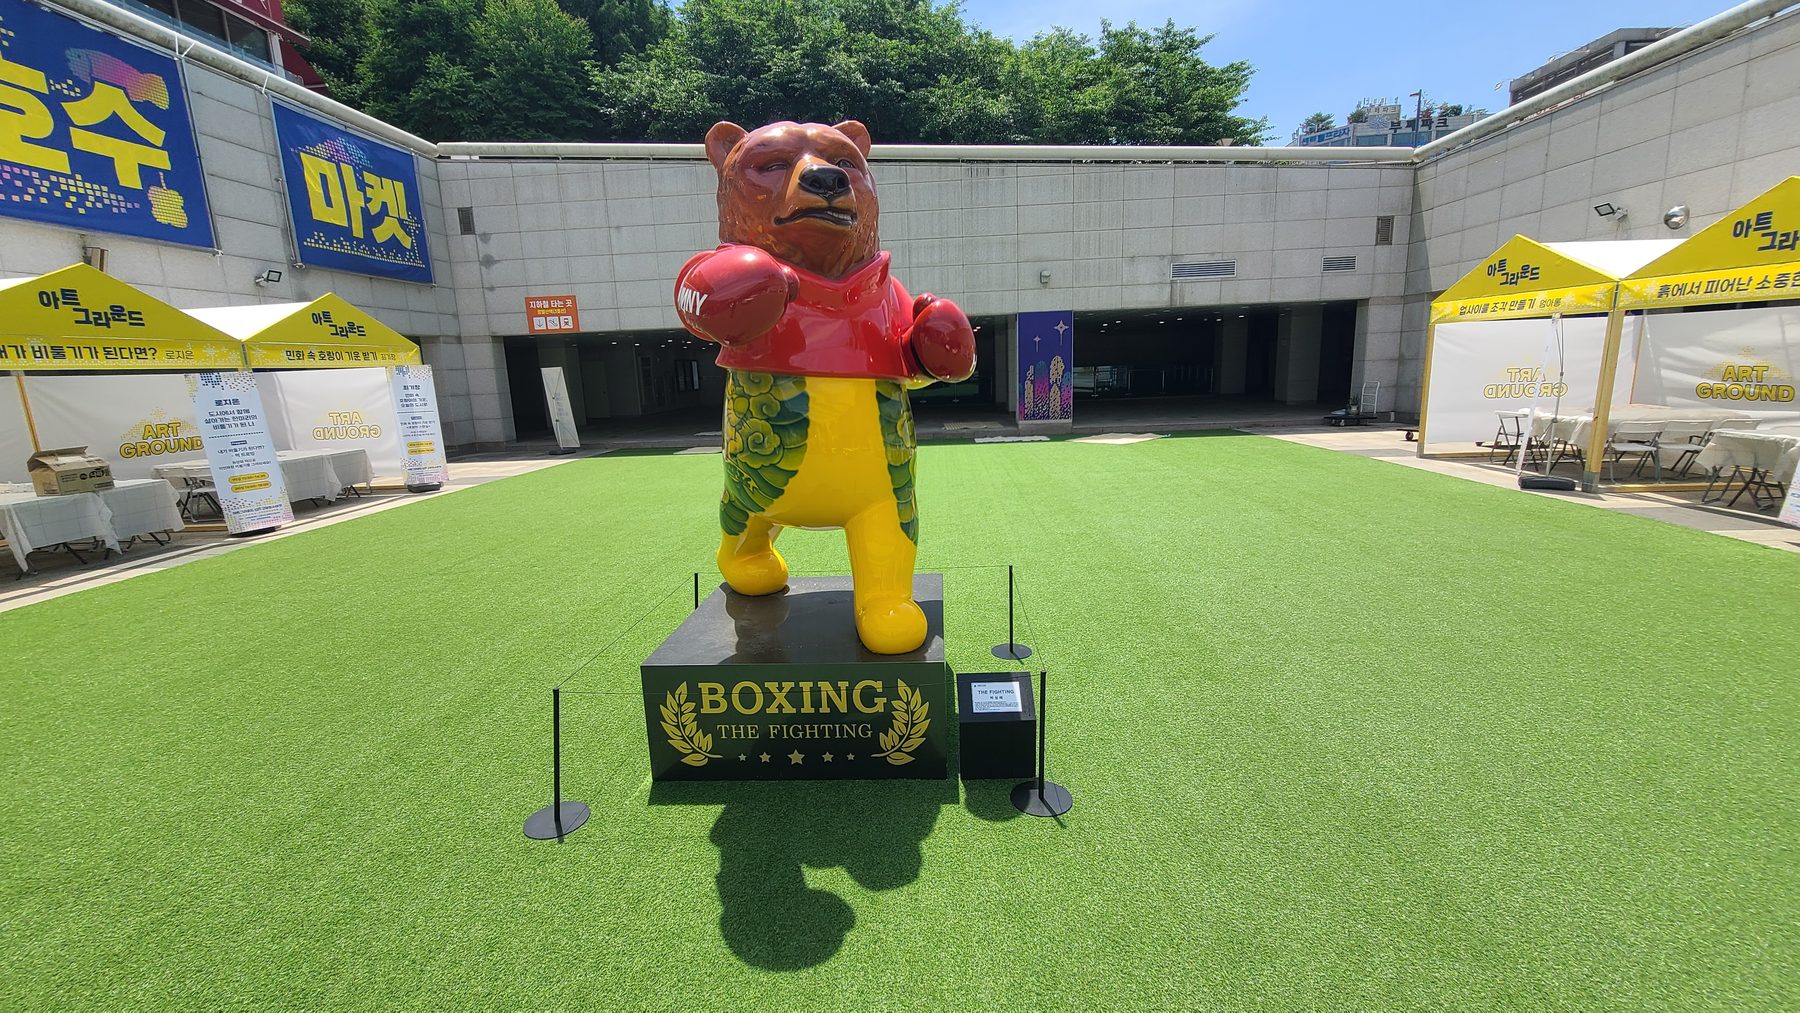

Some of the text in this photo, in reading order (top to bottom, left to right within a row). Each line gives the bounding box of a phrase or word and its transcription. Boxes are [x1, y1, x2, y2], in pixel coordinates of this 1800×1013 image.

[300, 152, 413, 249] 마켓
[1733, 211, 1773, 238] 아트
[1487, 258, 1507, 276] 아트
[1500, 264, 1540, 286] 그라운드
[1658, 280, 1700, 298] 흙에서
[1704, 276, 1753, 294] 피어난
[38, 288, 80, 309] 아트
[529, 299, 573, 308] 지하철 타는 곳
[1490, 301, 1508, 312] 조각
[1509, 298, 1536, 311] 만들기
[73, 304, 145, 328] 그라운드
[311, 310, 333, 325] 아트
[329, 321, 366, 338] 그라운드
[32, 345, 99, 360] 비둘기가
[103, 347, 157, 361] 된다면?
[165, 350, 194, 360] 로지은
[286, 350, 304, 361] 민화
[307, 350, 316, 361] 속
[318, 351, 343, 361] 호랑이
[345, 351, 361, 361] 기운
[362, 351, 378, 361] 받기
[1722, 365, 1769, 383] ART
[1696, 383, 1795, 402] GROUND
[143, 422, 181, 440] ART
[120, 436, 204, 458] GROUND
[698, 680, 887, 715] BOXING
[717, 723, 873, 739] THE FIGHTING
